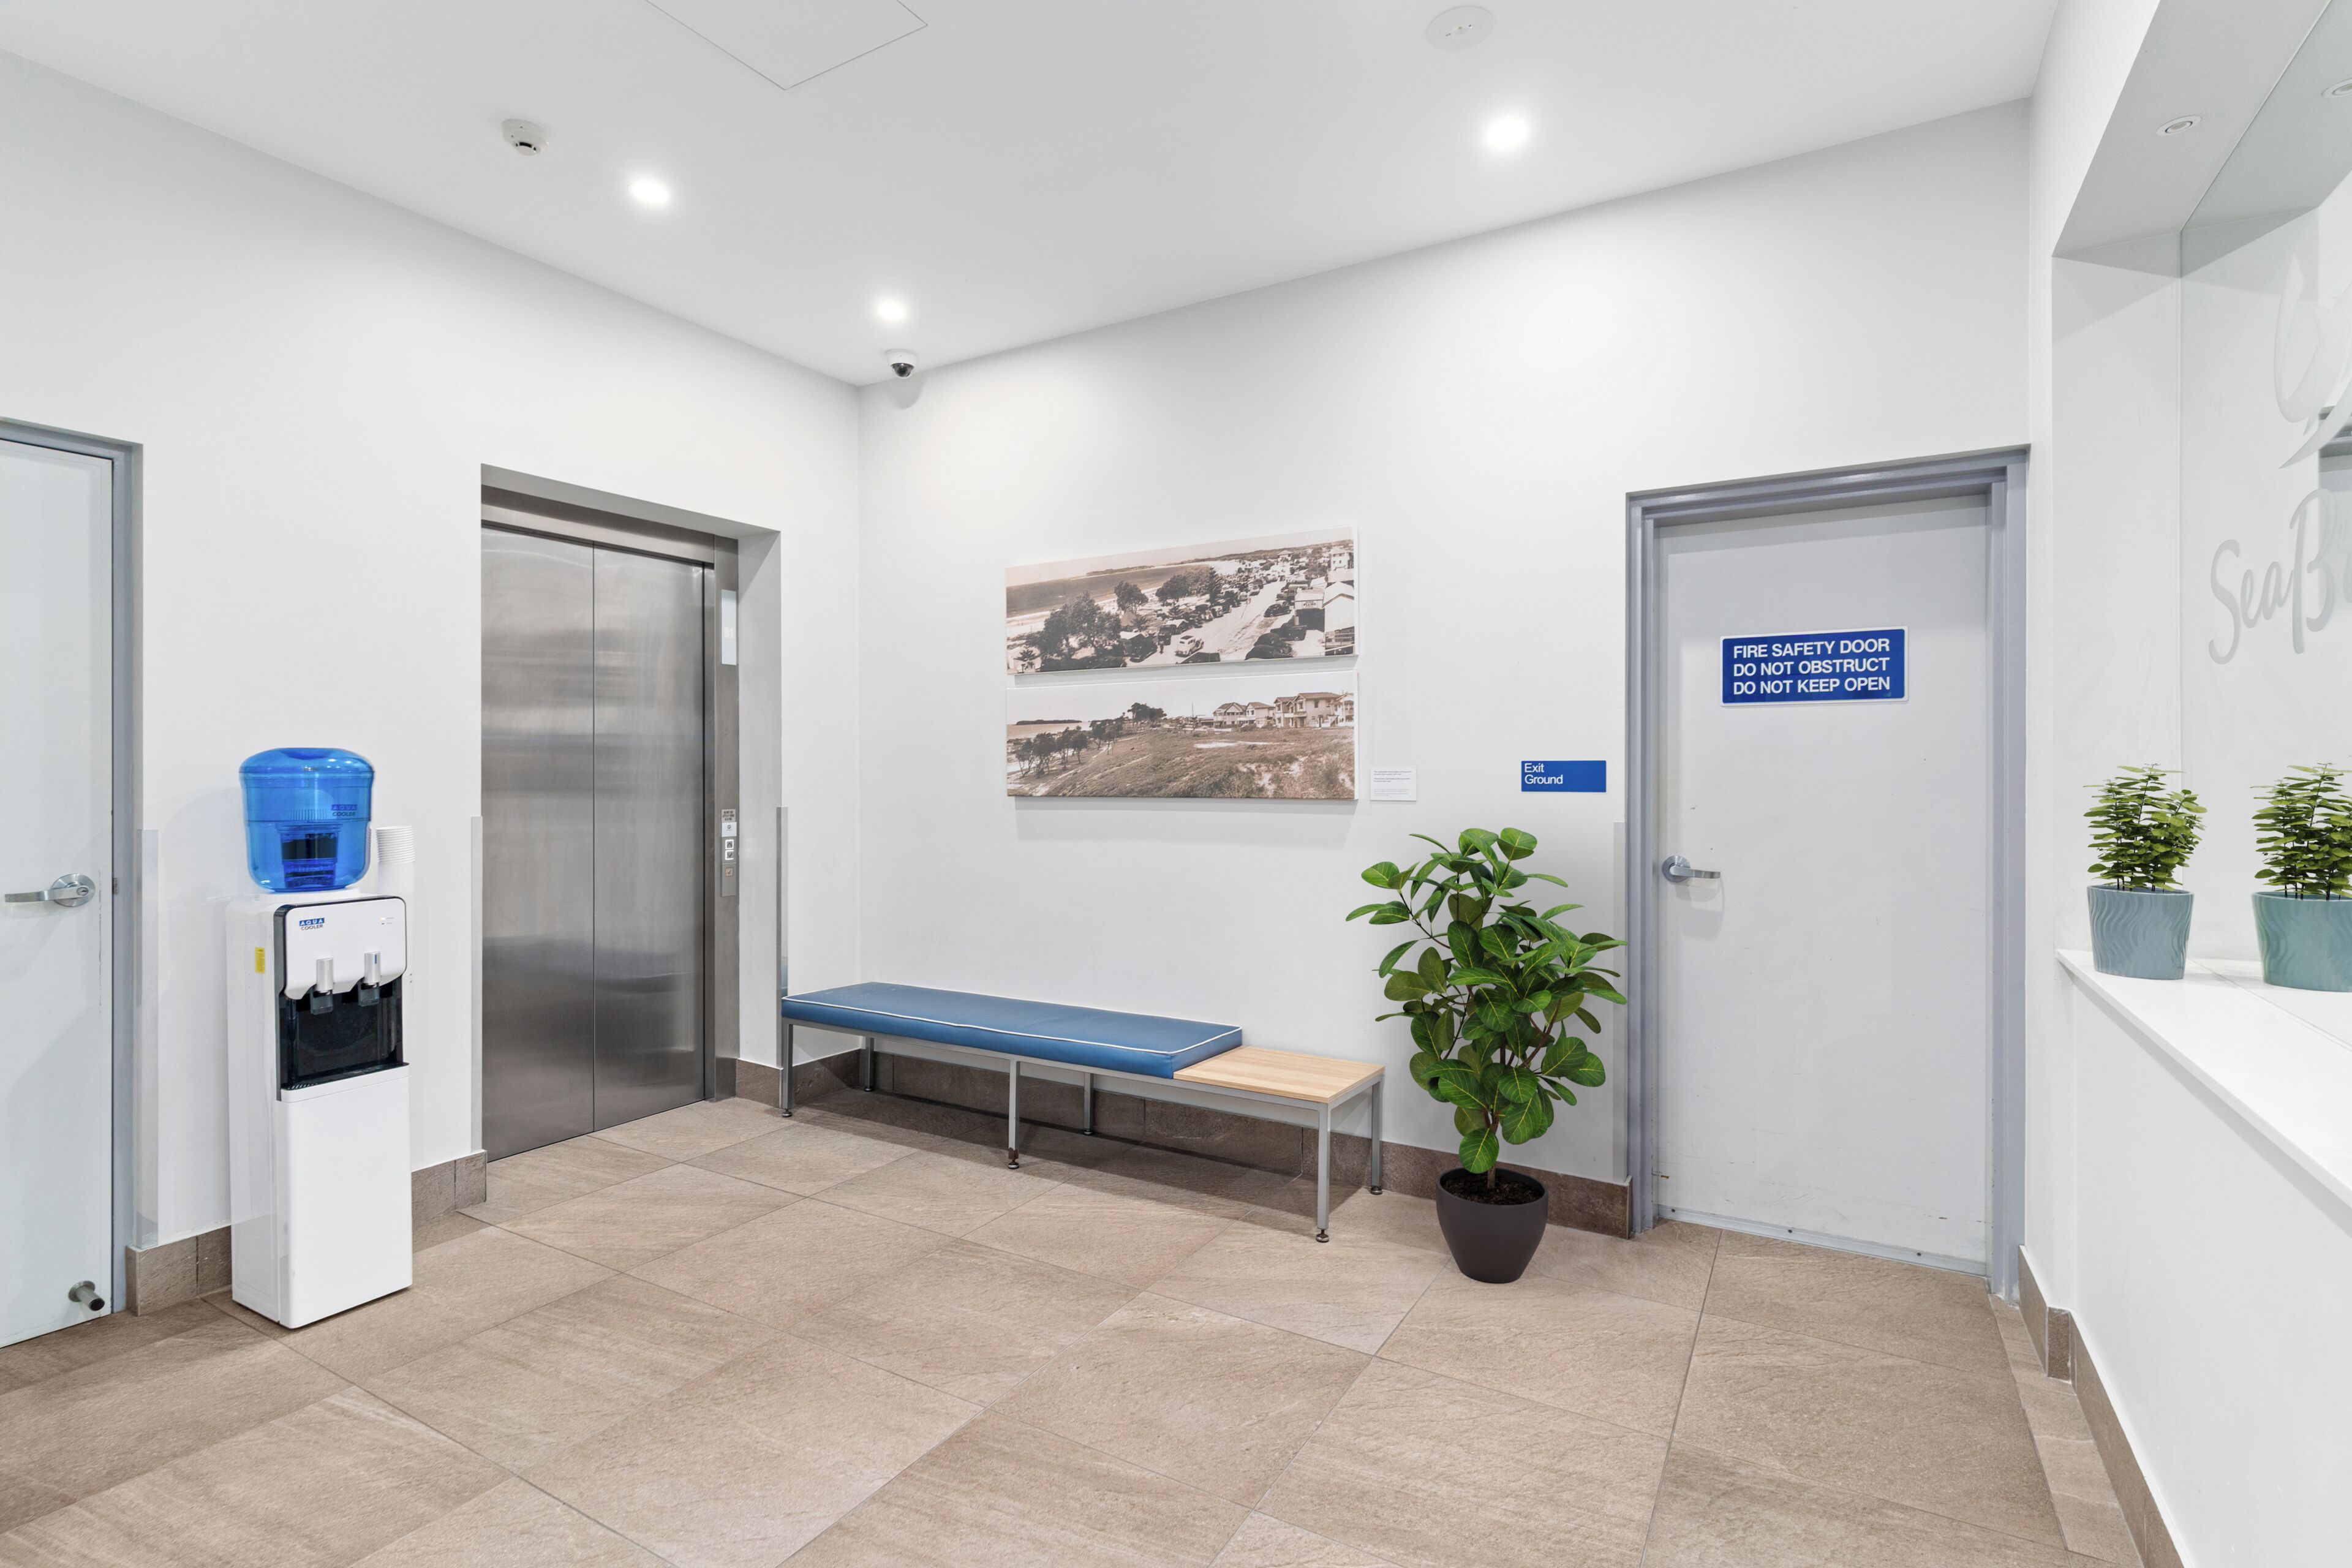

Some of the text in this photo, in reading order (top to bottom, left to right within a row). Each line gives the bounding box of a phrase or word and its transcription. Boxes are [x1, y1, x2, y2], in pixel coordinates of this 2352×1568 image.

[724, 627, 734, 639] B1
[1733, 638, 1890, 658] FIRE SAFETY DOOR
[1733, 657, 1890, 677] DO NOT OBSTRUCT
[1733, 676, 1890, 695] DO NOT KEEP OPEN
[1525, 763, 1544, 773] Exit
[1525, 774, 1563, 785] Ground
